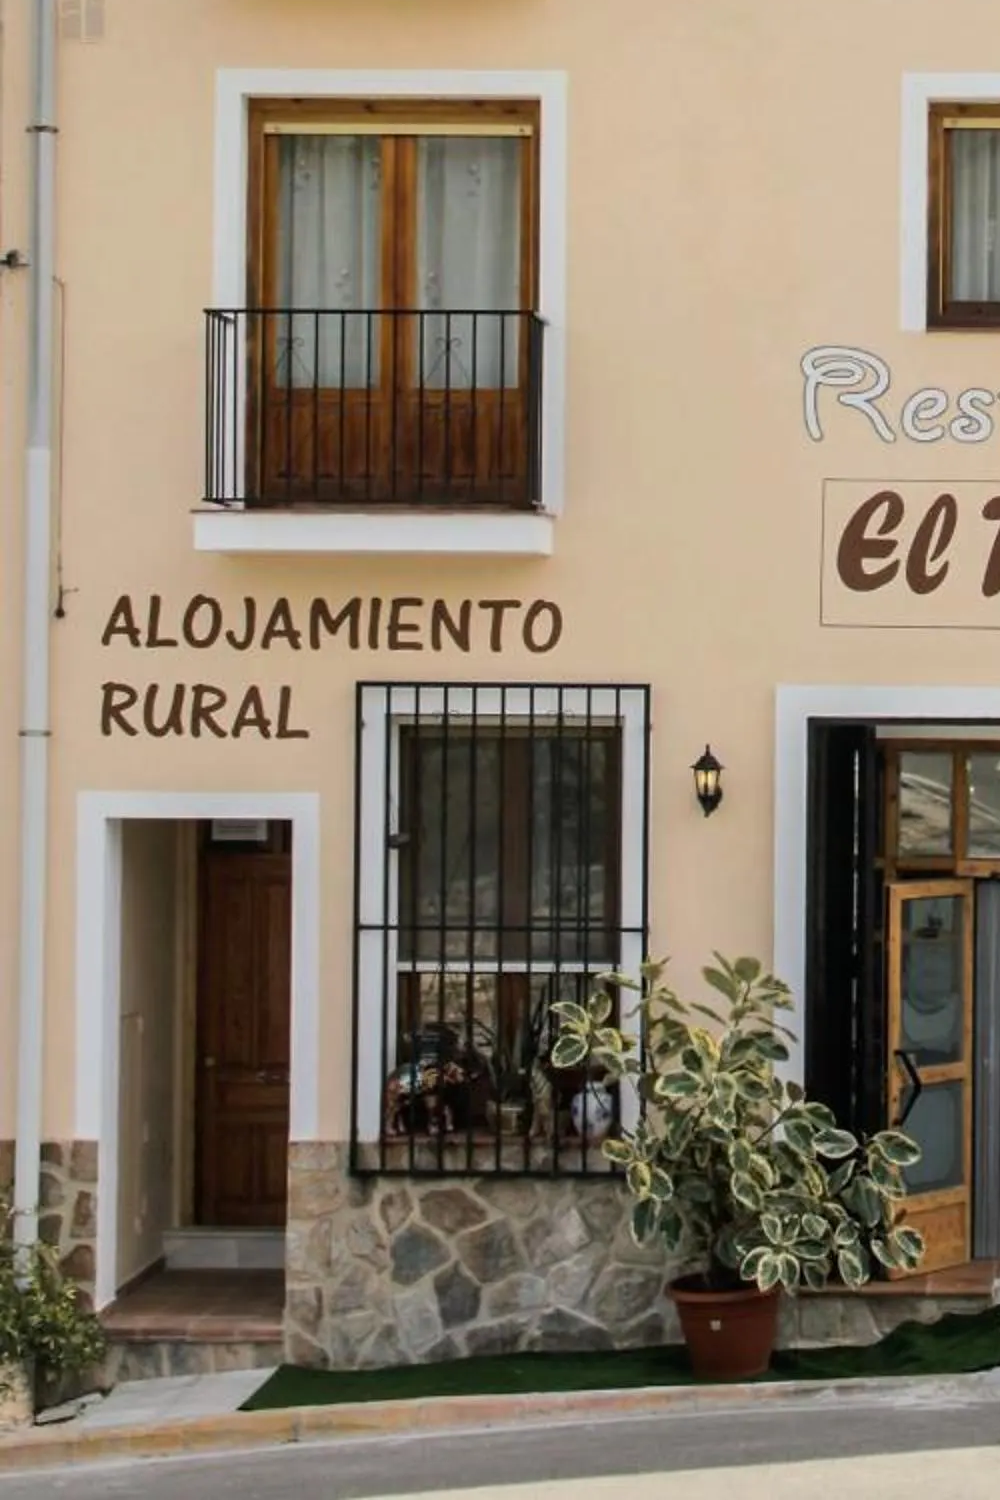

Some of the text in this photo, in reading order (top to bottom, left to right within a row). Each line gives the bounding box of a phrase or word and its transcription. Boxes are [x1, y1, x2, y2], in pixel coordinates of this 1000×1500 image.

[835, 490, 959, 596] El
[101, 593, 564, 654] ALOJAMIENTO
[100, 681, 310, 739] RURAL
